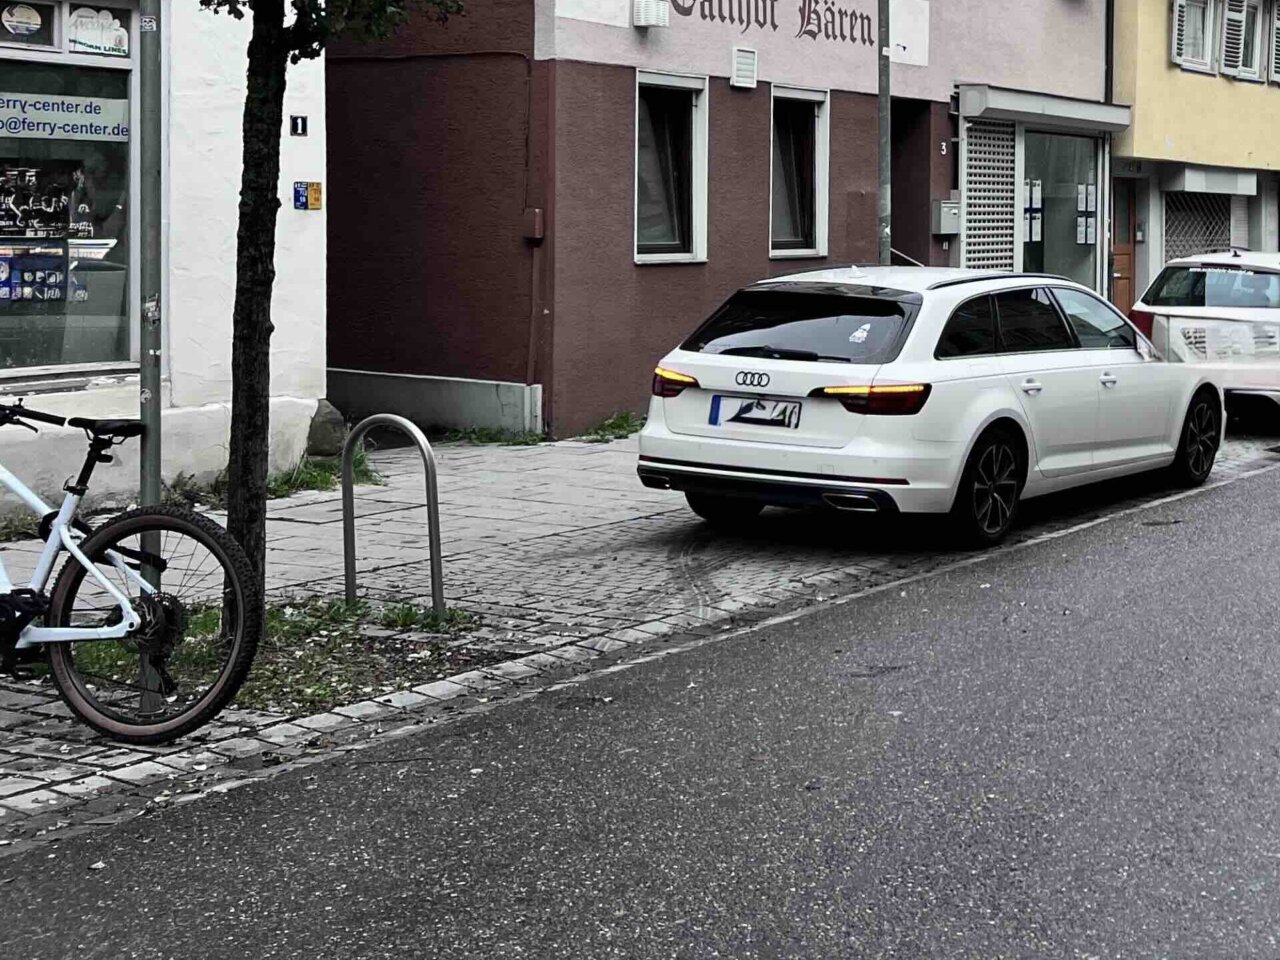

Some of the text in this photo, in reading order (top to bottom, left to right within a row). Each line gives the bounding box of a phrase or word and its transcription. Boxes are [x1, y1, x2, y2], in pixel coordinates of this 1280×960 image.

[103, 45, 127, 55] LINES
[296, 117, 303, 134] 1
[940, 142, 947, 155] 3
